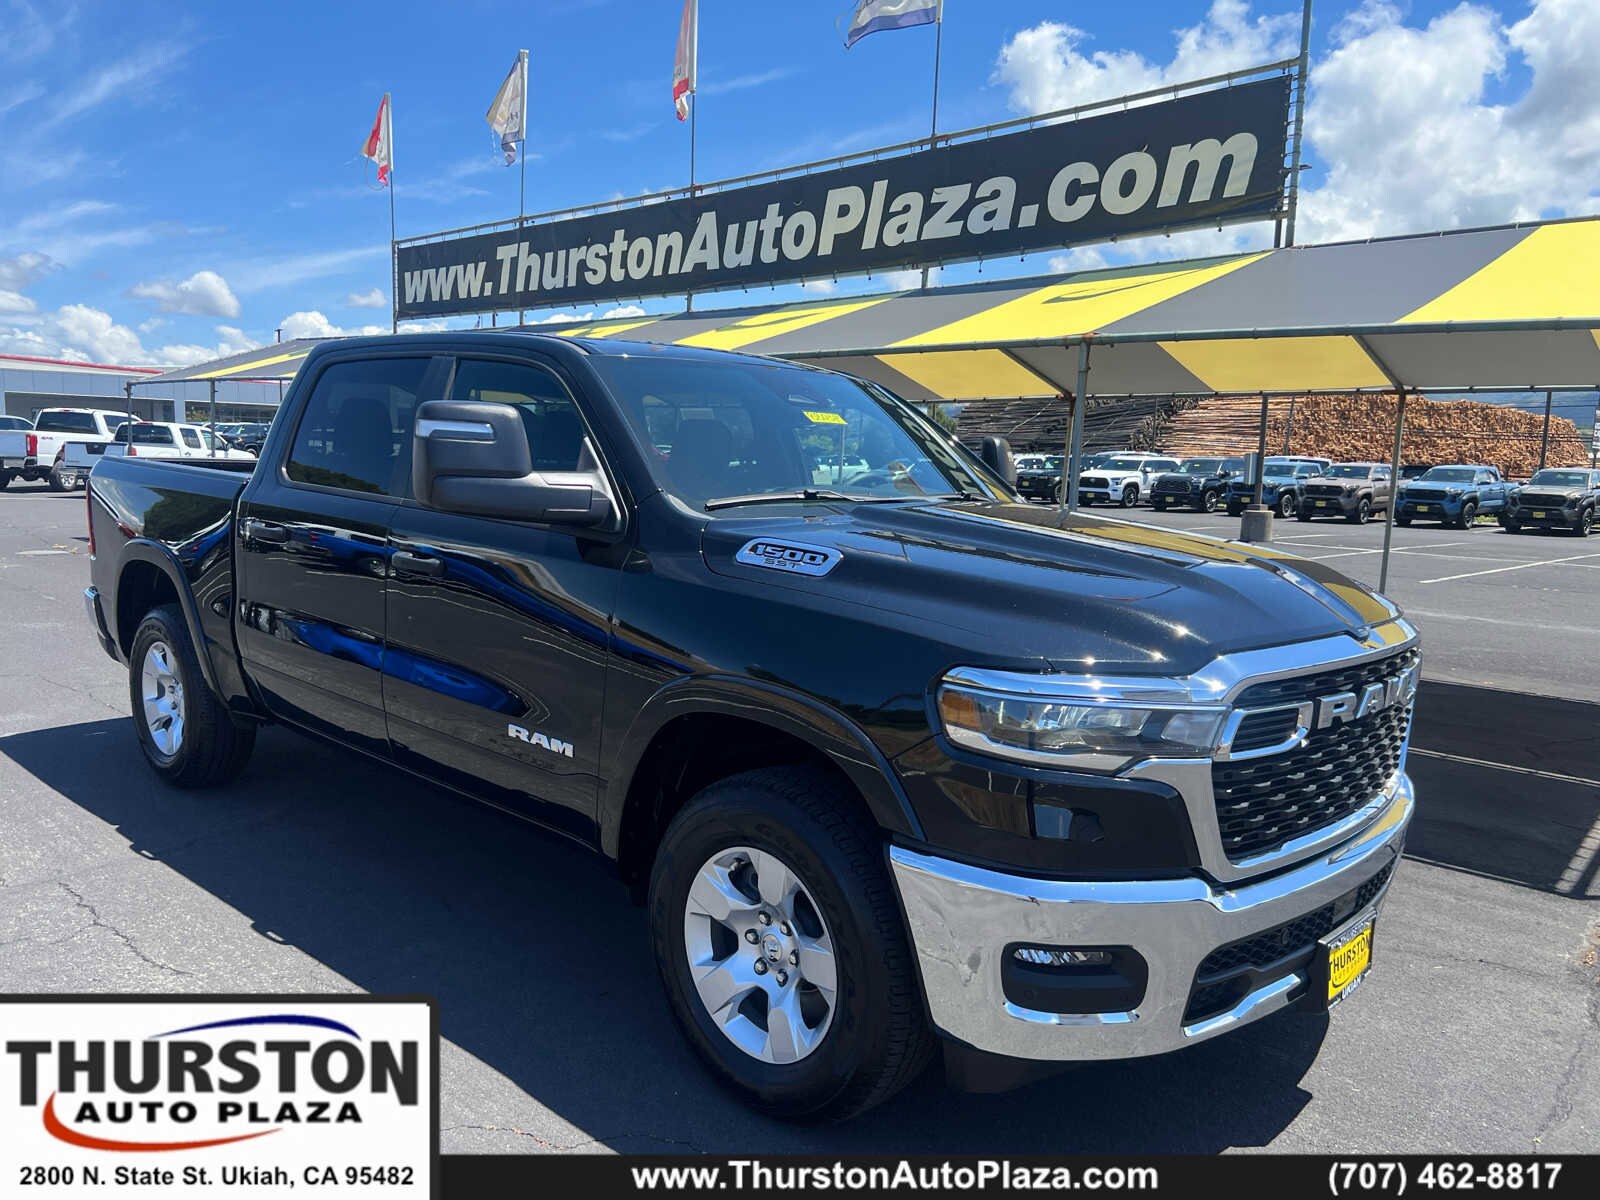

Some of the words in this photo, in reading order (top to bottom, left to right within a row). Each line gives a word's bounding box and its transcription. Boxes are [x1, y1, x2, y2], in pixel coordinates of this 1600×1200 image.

[403, 132, 1259, 304] www.ThurstonAutoPlaza.com
[748, 543, 826, 565] 1500
[1317, 667, 1415, 730] RAM
[507, 723, 574, 758] RAM
